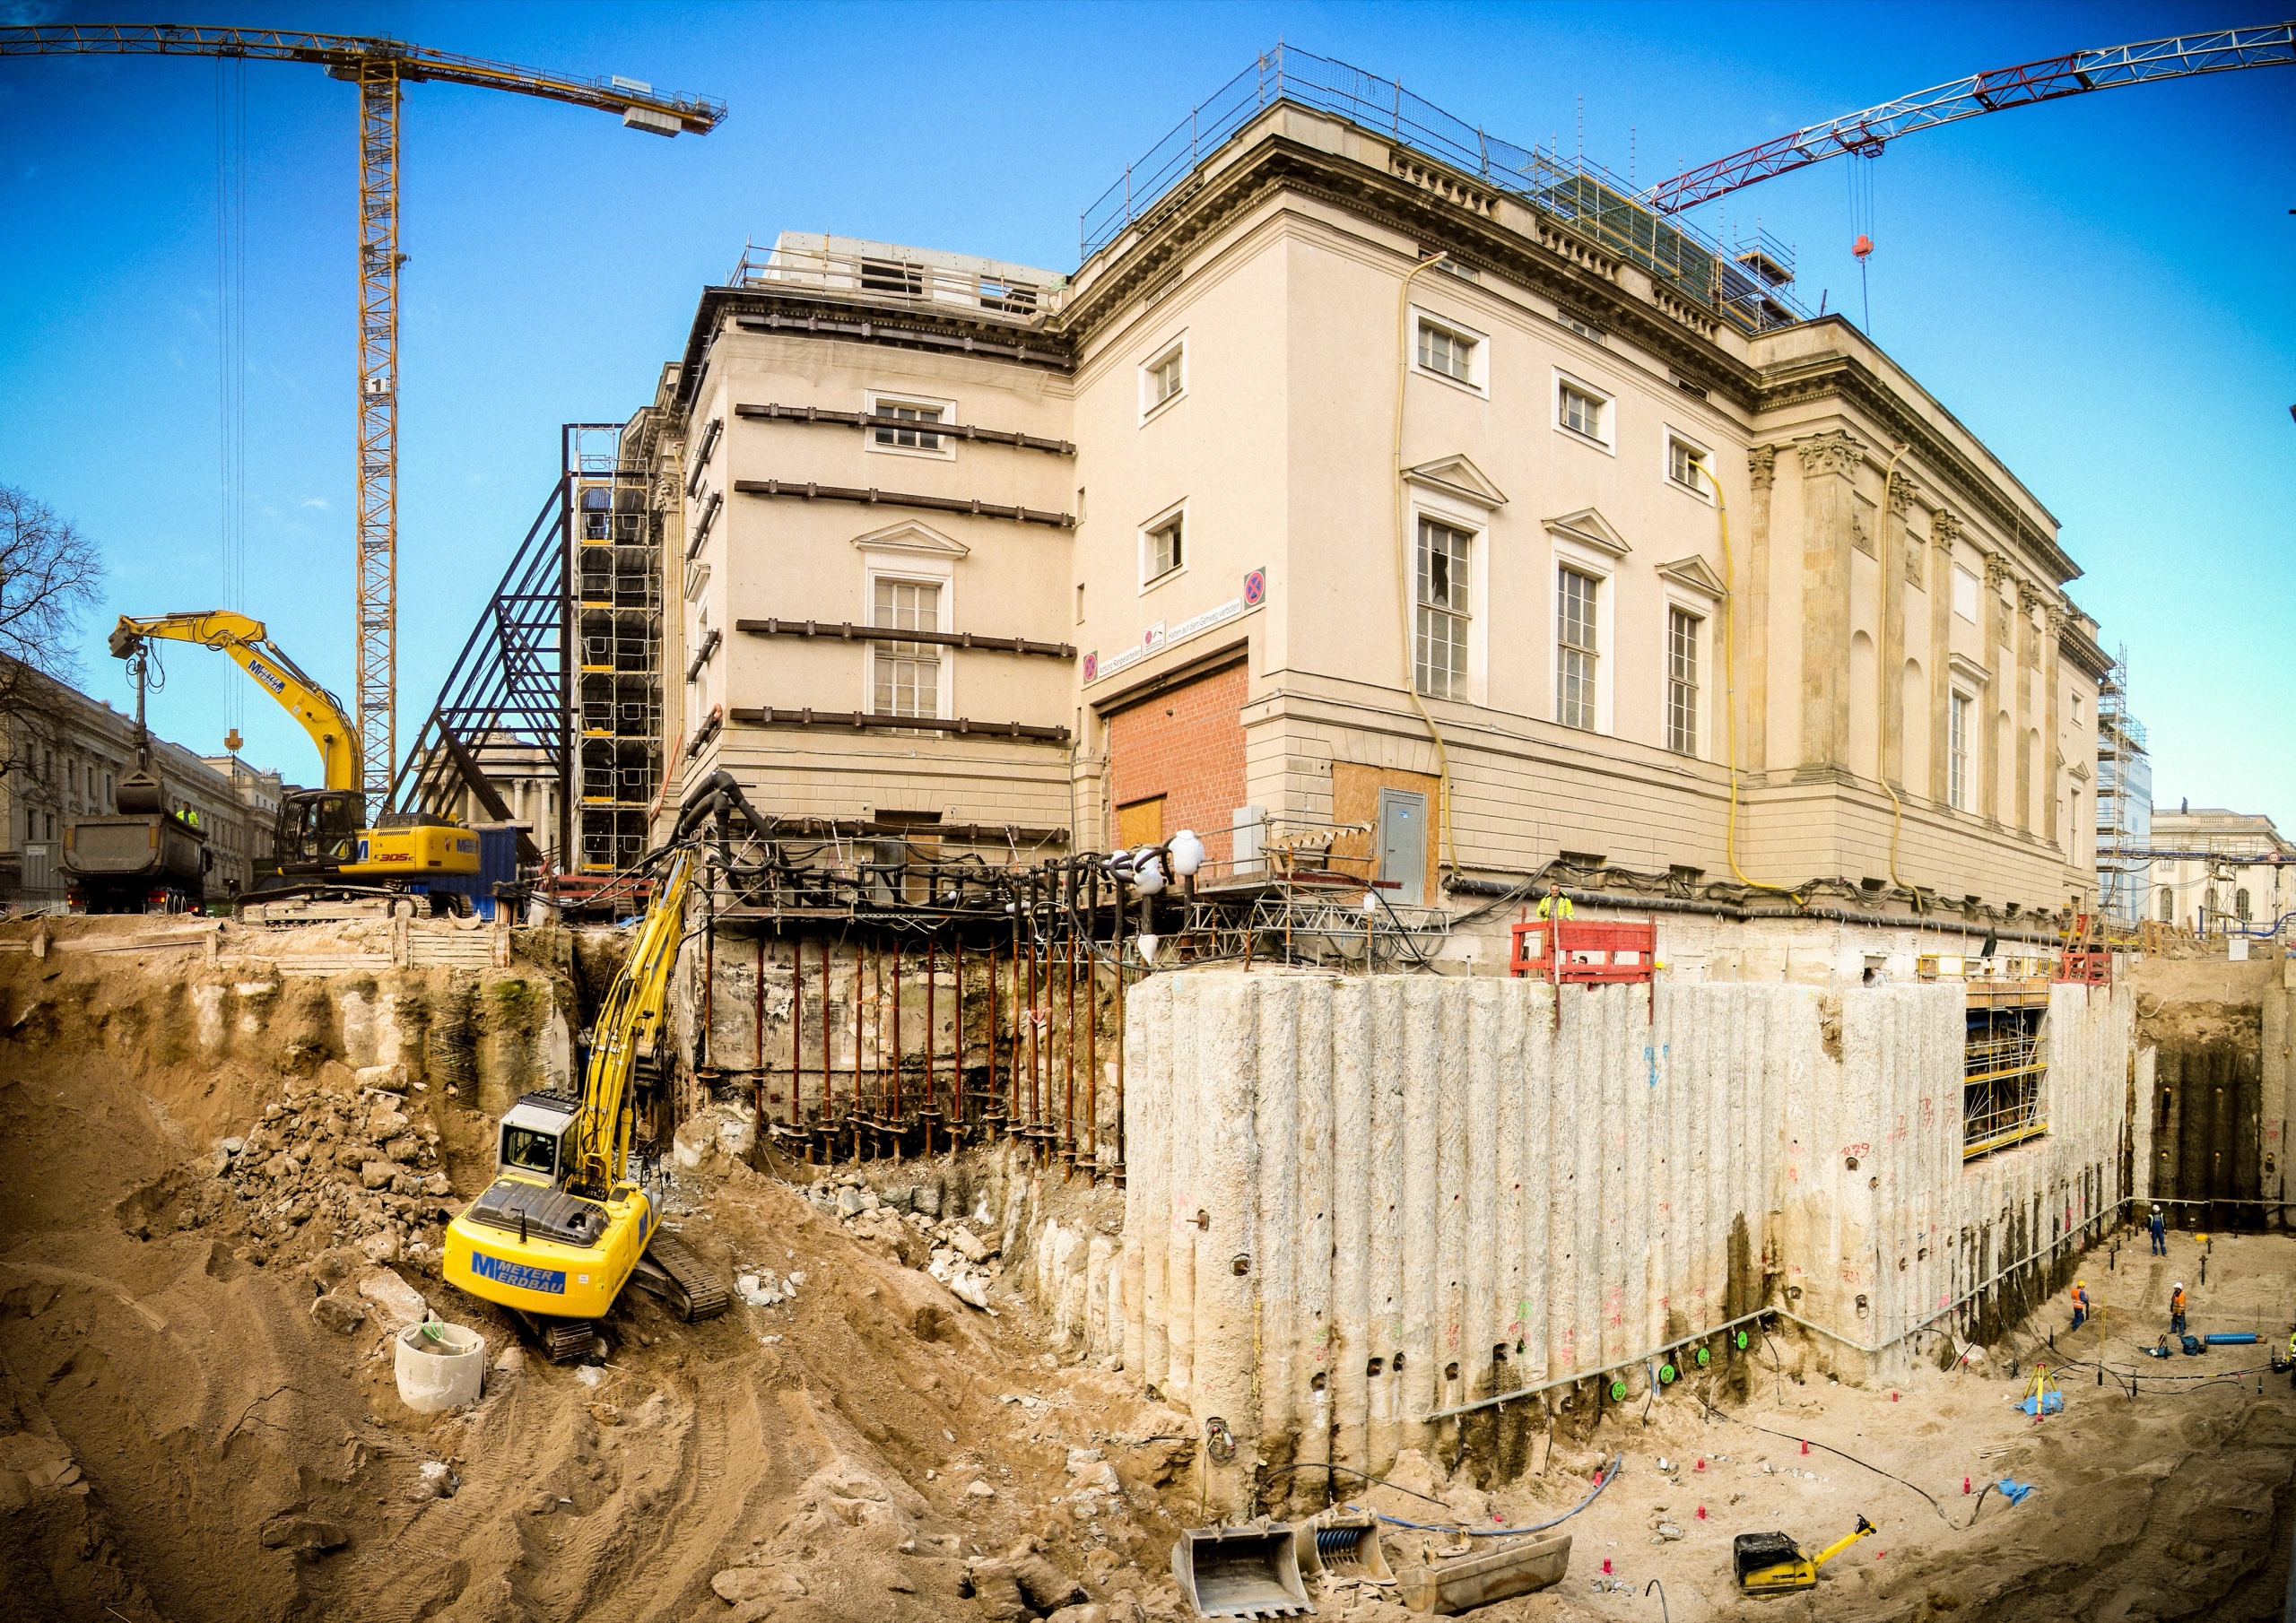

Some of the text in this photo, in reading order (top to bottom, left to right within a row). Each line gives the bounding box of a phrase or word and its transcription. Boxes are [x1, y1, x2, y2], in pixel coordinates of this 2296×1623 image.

[372, 379, 381, 392] 1
[1168, 629, 1181, 640] Halten
[1189, 621, 1199, 631] dem
[1200, 612, 1219, 626] Gehweg
[1220, 603, 1239, 618] verboten
[257, 672, 283, 693] ERDBAU
[260, 666, 283, 686] MEYER
[379, 854, 409, 862] 305
[471, 1250, 554, 1280] M MEYER
[497, 1272, 563, 1293] ERDBAU
